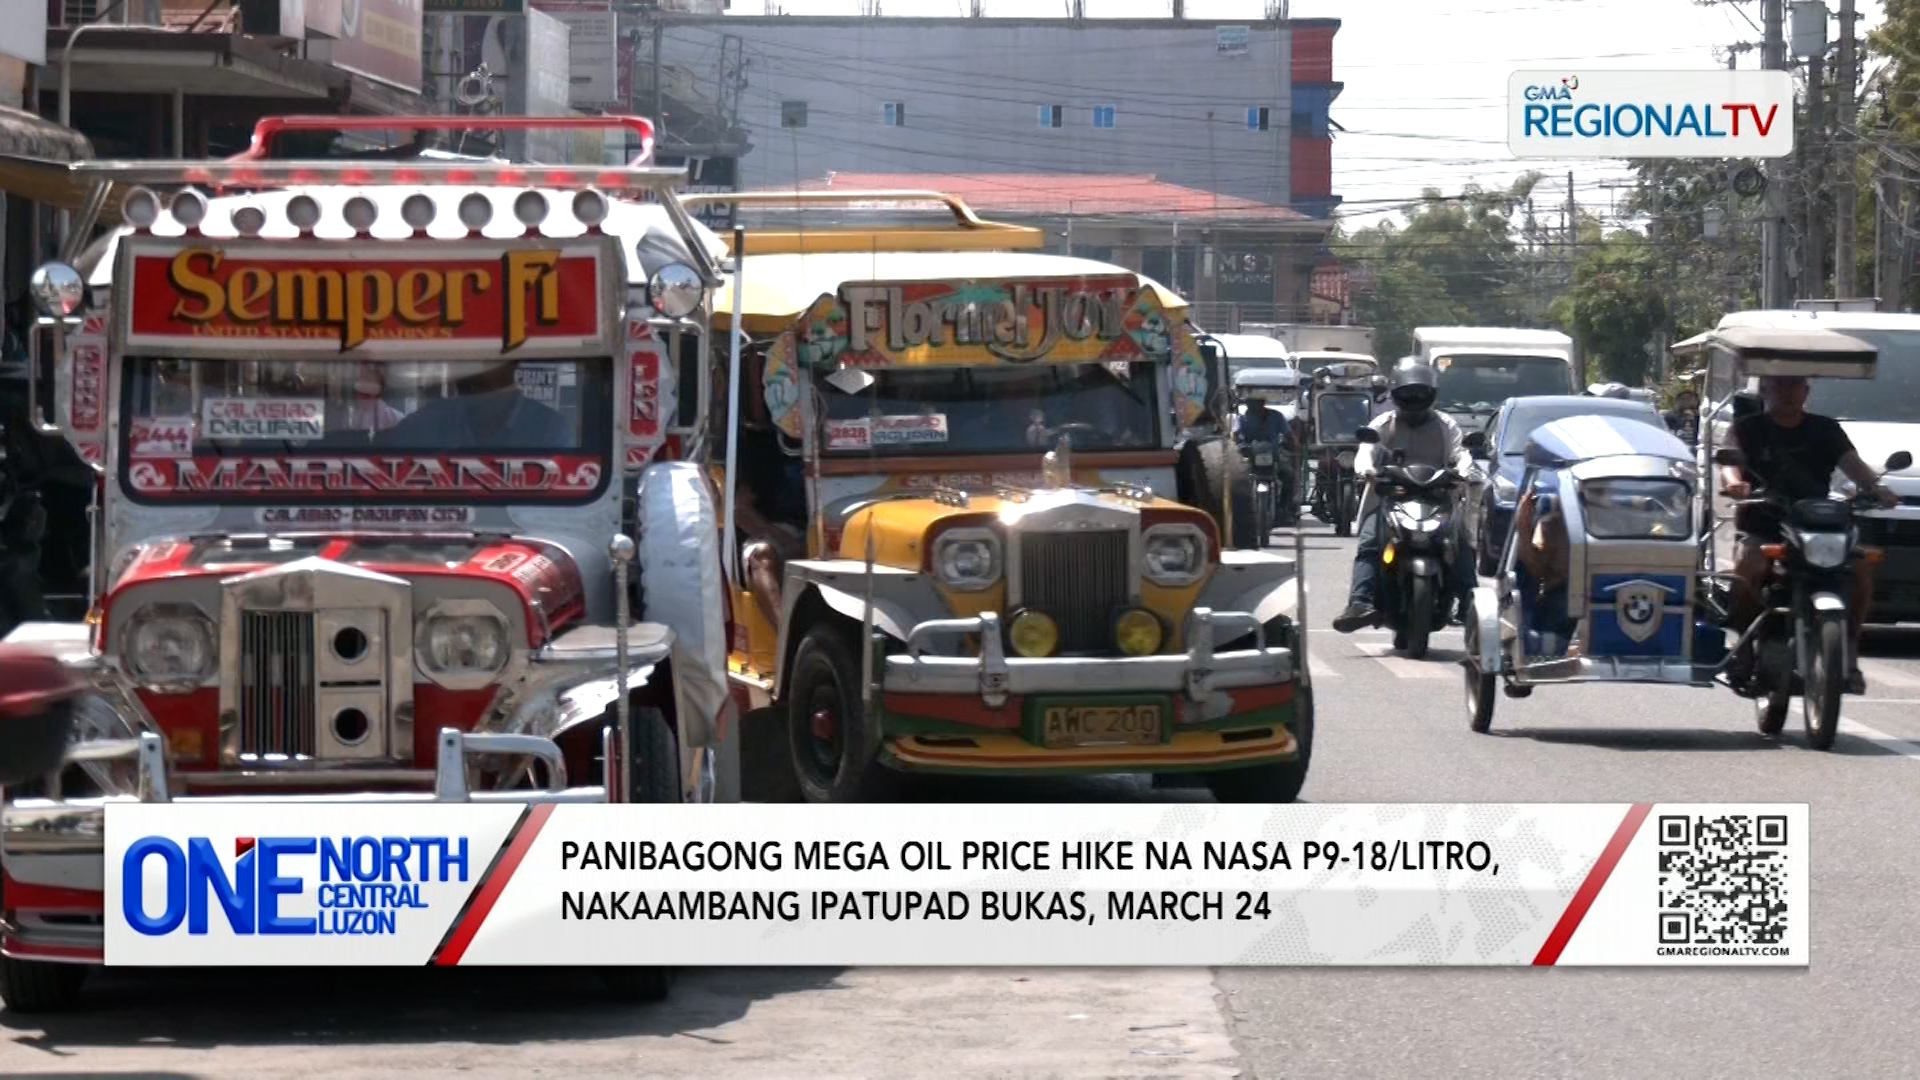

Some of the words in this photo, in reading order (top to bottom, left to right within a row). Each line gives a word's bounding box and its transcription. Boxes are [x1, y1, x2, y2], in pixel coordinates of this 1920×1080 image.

[169, 247, 491, 352] Semper
[192, 327, 258, 338] UNITED
[265, 328, 340, 340] STATES
[368, 328, 453, 340] MARINES
[210, 402, 317, 418] CALASIAO
[209, 419, 320, 434] DAGUPAN
[175, 458, 561, 491] MARNAND
